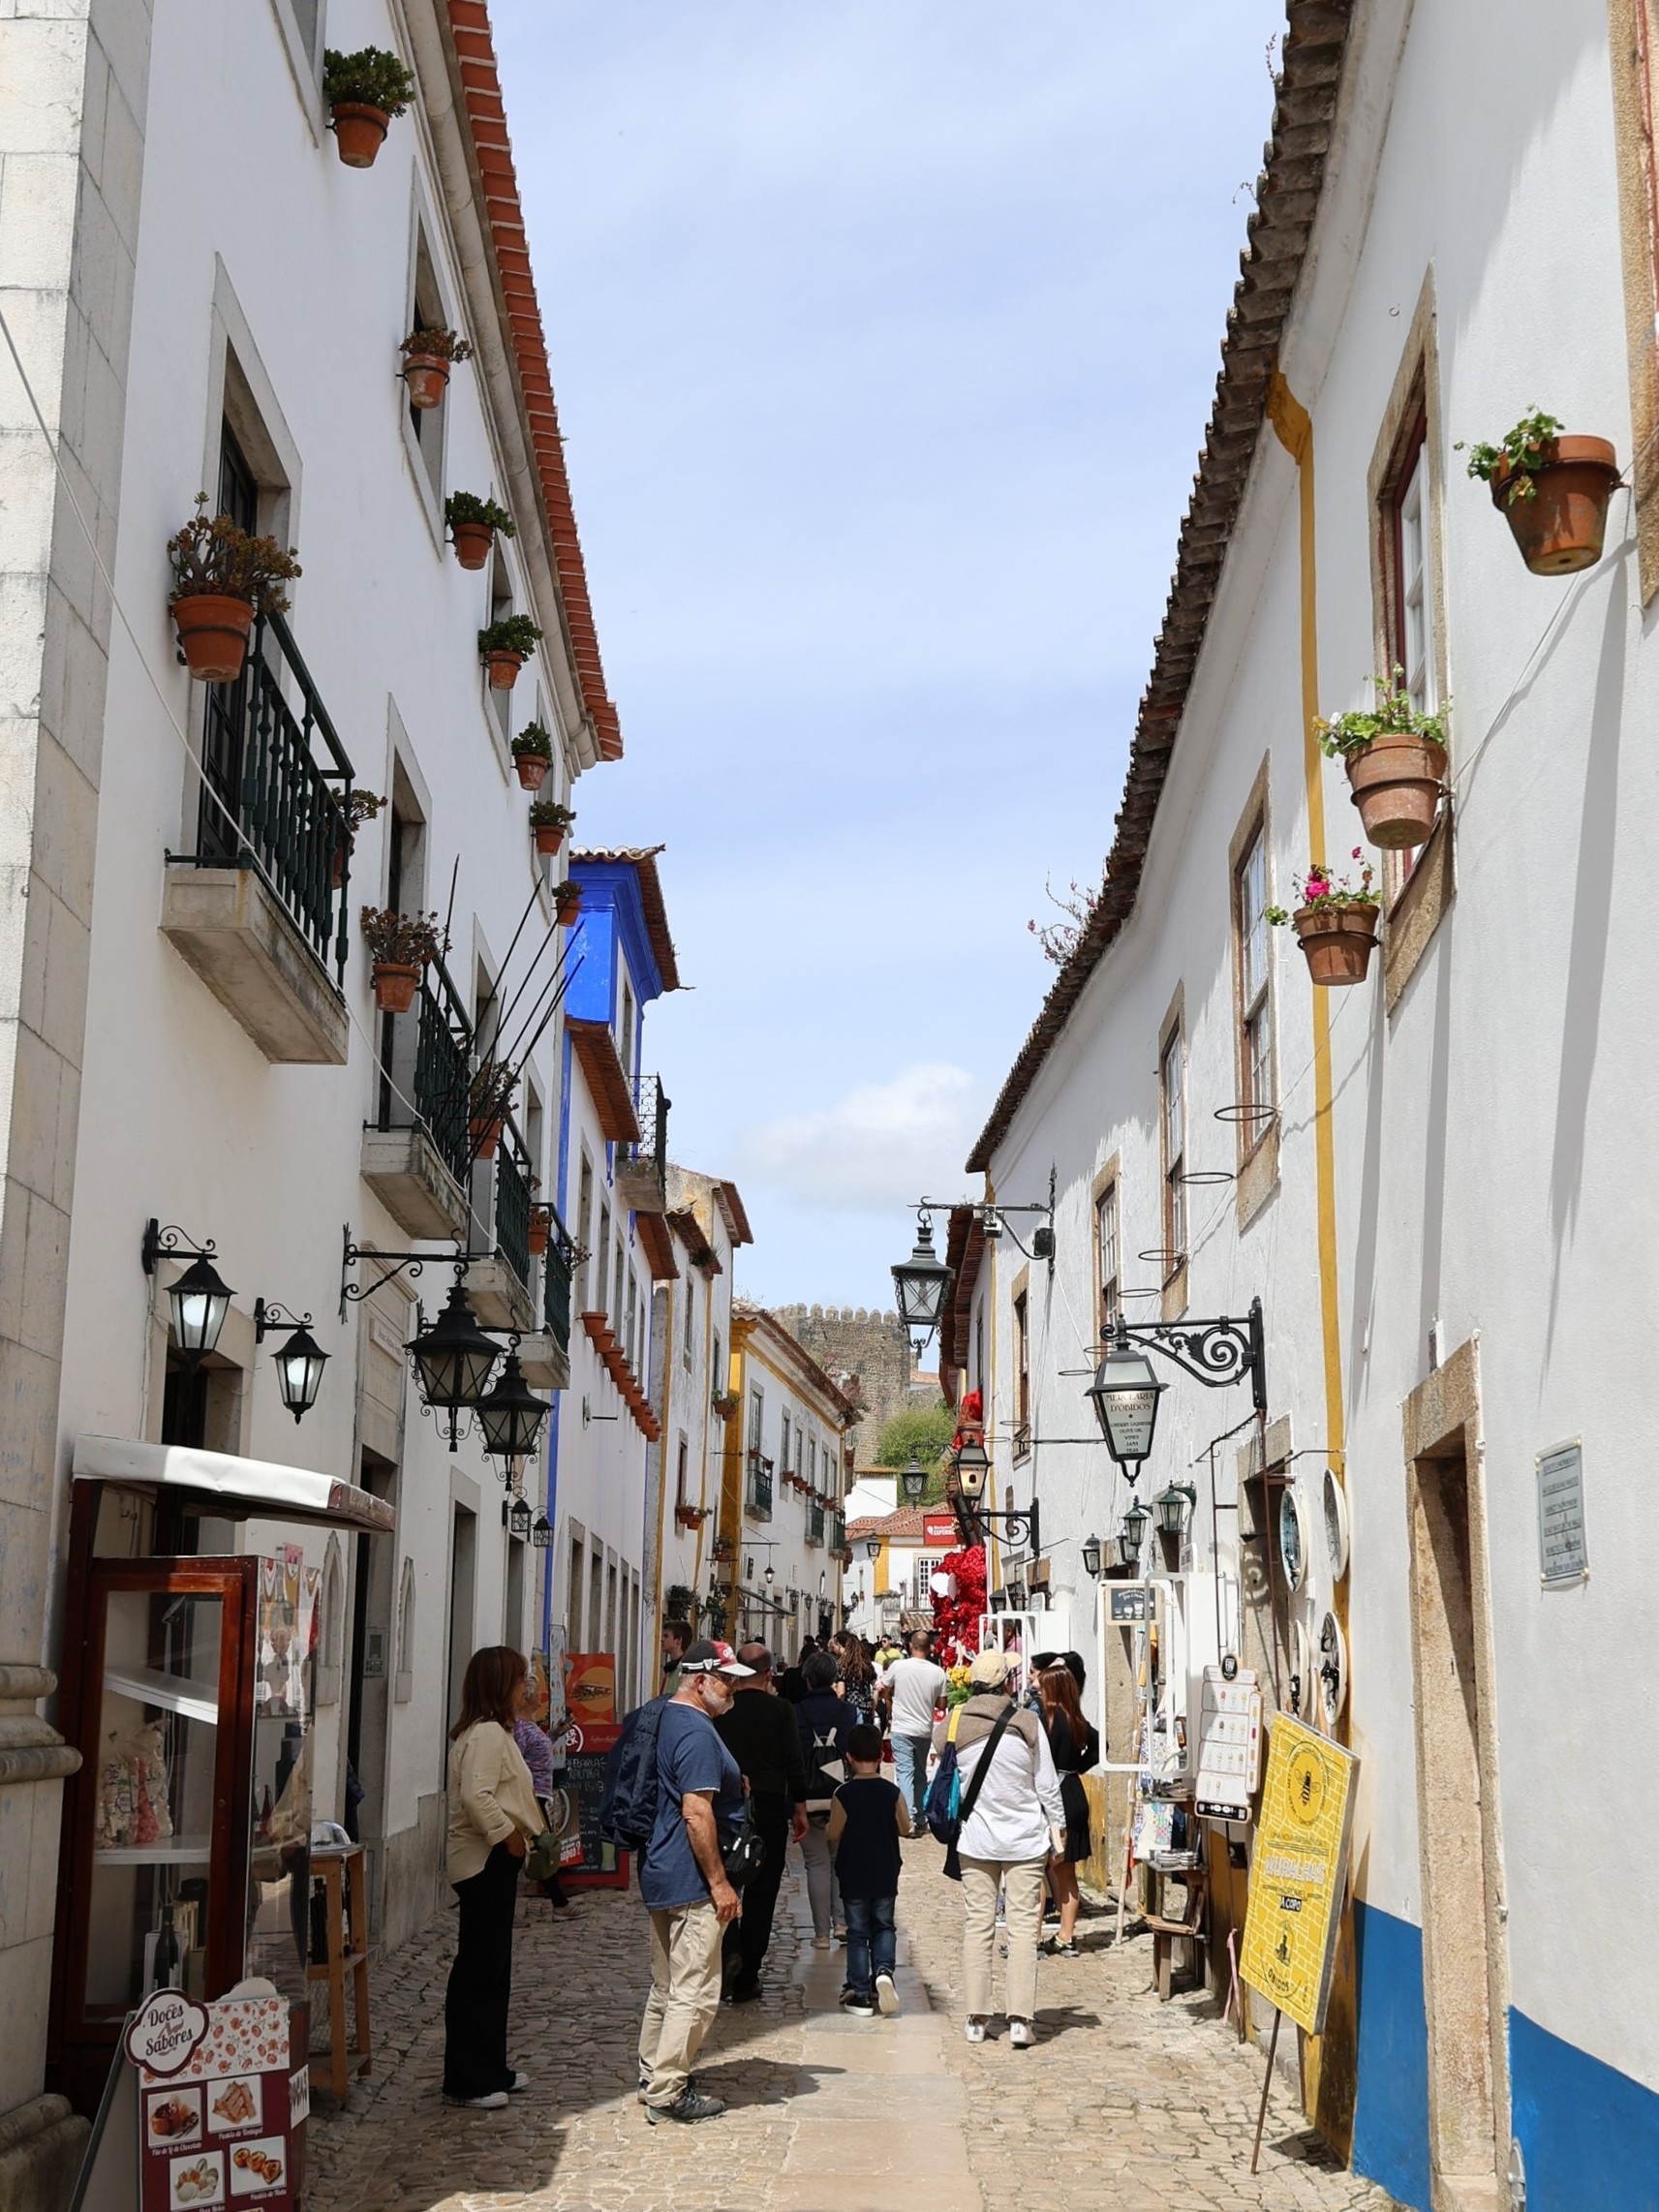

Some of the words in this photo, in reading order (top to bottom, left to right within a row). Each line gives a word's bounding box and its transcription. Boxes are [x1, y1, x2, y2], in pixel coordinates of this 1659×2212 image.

[1265, 1856, 1326, 1886] MURALHAS
[148, 2005, 184, 2027] Doces
[145, 2028, 194, 2056] Sabores
